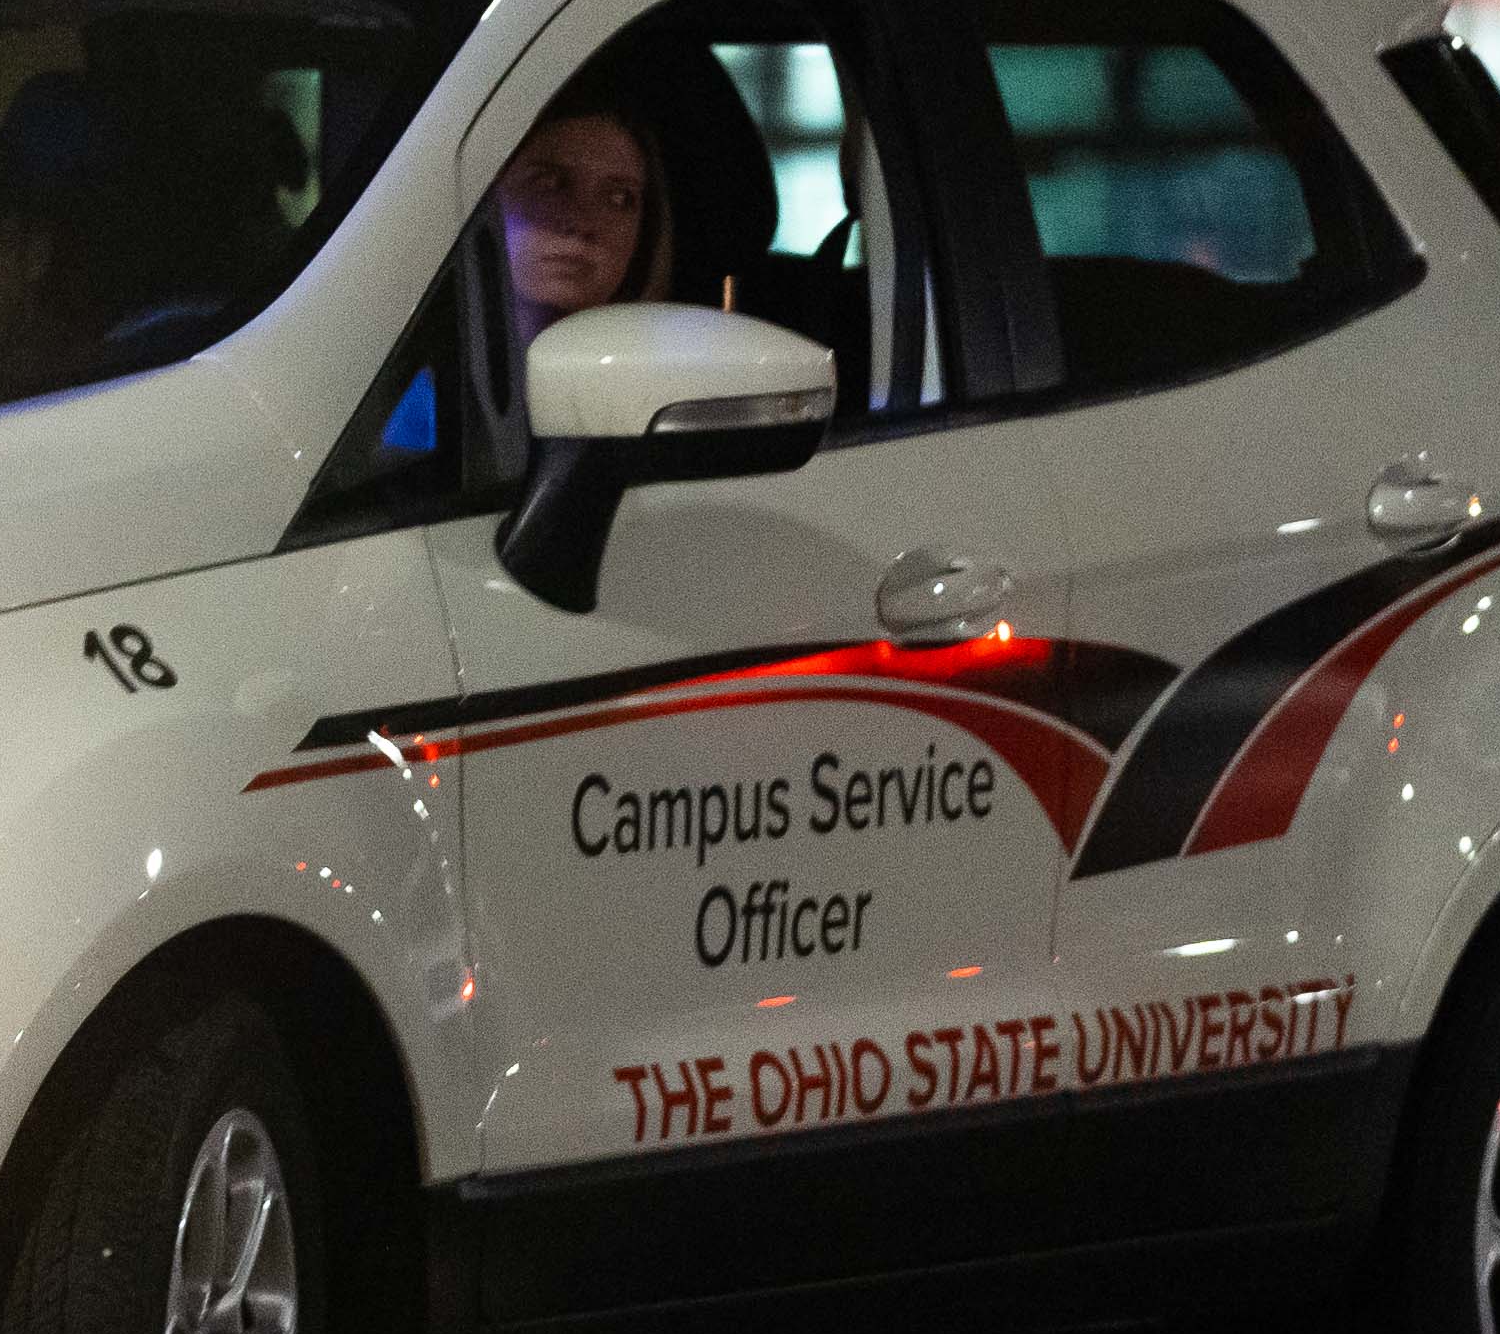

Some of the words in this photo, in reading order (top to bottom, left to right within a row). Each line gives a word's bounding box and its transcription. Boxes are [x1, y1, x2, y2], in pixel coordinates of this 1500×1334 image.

[83, 623, 178, 694] 18
[571, 772, 791, 867] Campus
[809, 742, 995, 834] Service
[696, 878, 873, 967] Officer
[614, 1056, 734, 1142] THE
[748, 1038, 892, 1127] OHIO
[905, 1015, 1061, 1108] STATE
[1072, 973, 1356, 1084] UNIVERSITY
